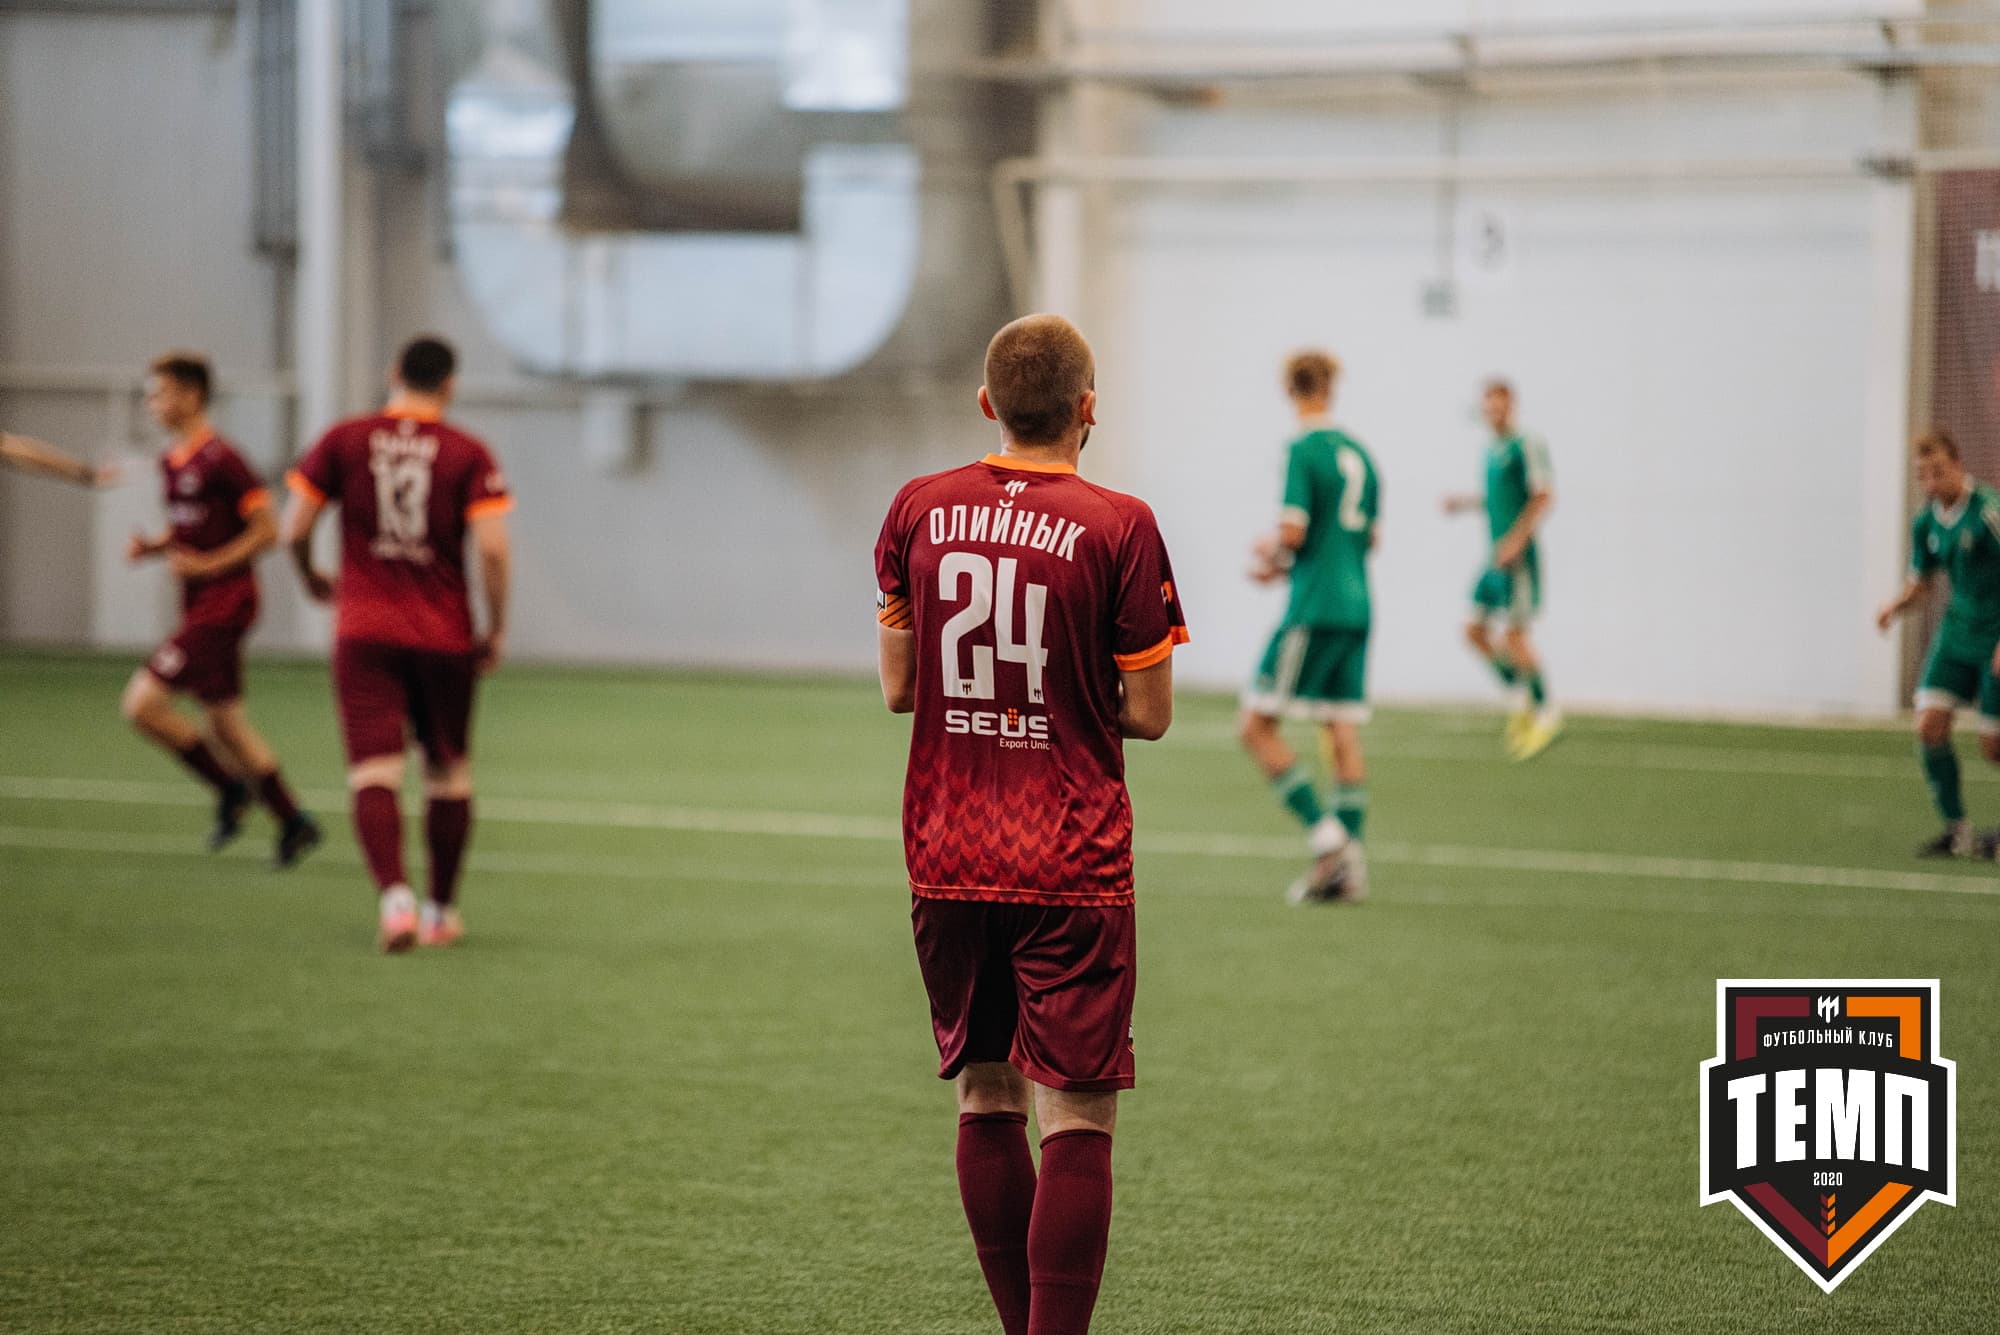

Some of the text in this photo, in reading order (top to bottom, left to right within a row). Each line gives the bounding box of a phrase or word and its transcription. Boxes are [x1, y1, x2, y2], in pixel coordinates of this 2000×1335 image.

[929, 499, 1086, 562] ОЛИЙНЫК
[938, 551, 1049, 704] 24
[1000, 738, 1028, 750] Export
